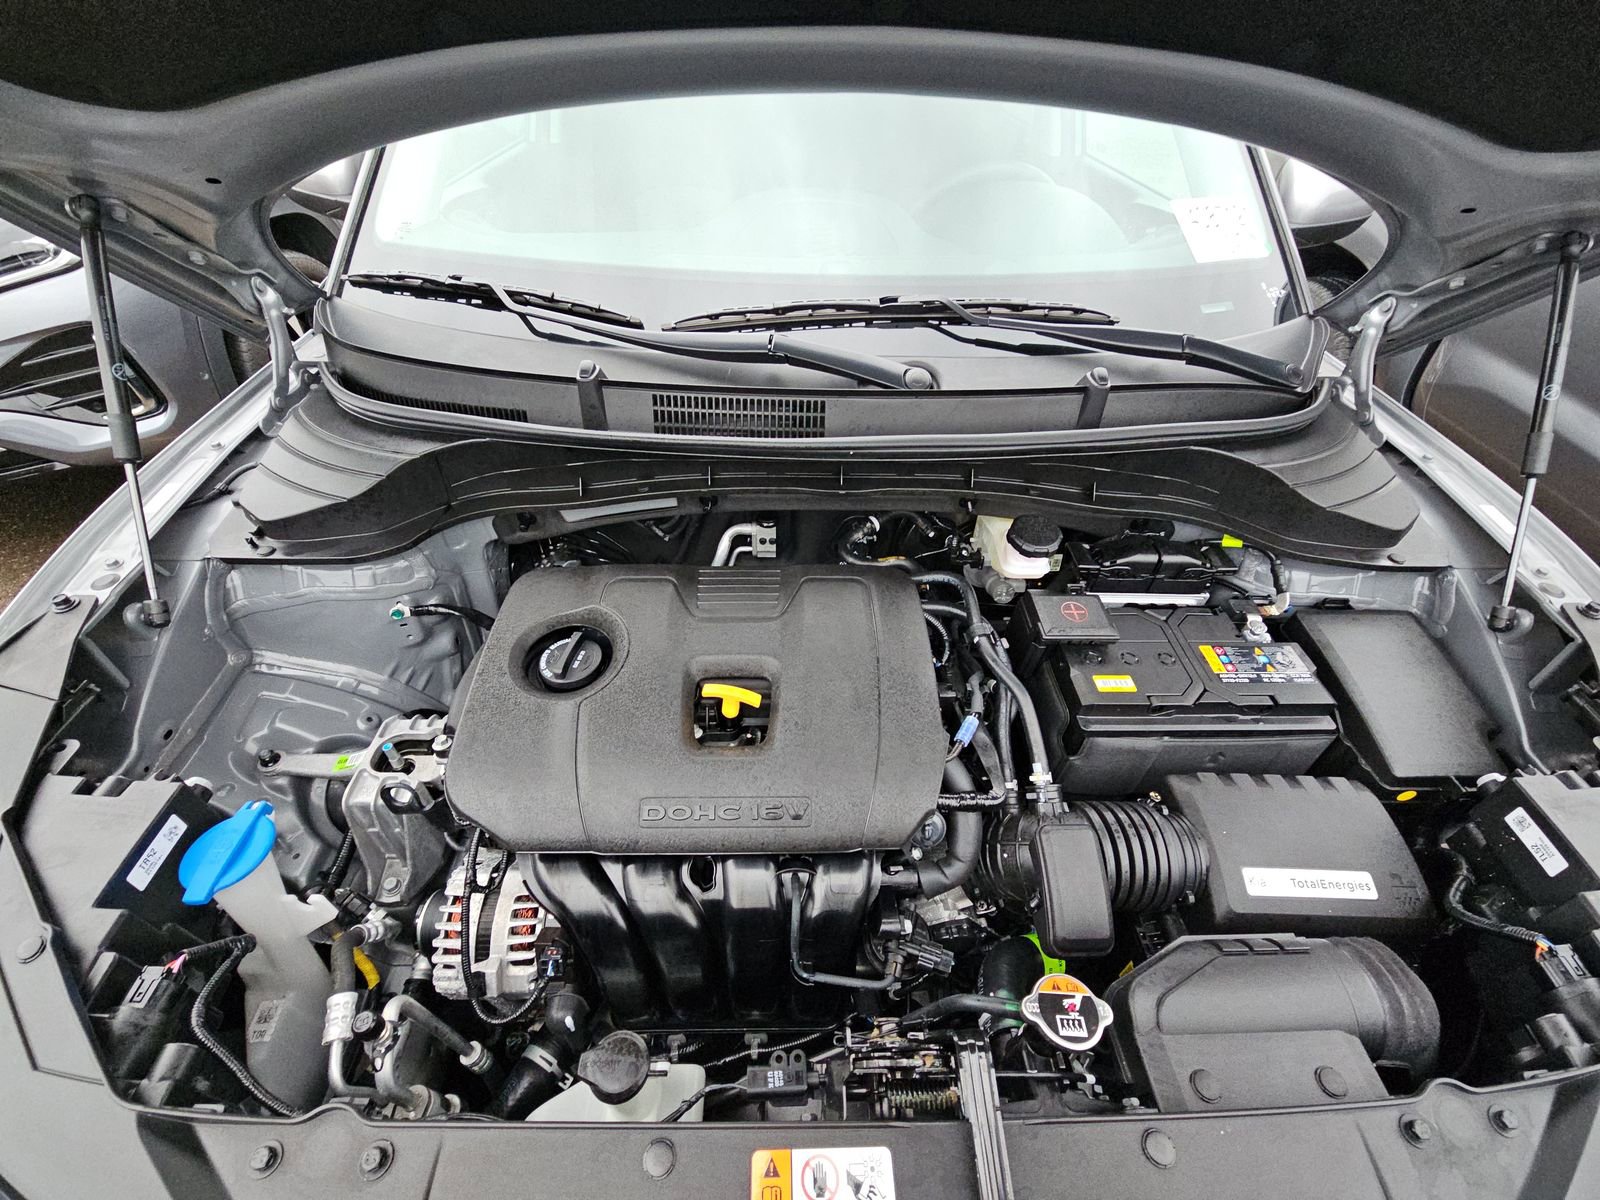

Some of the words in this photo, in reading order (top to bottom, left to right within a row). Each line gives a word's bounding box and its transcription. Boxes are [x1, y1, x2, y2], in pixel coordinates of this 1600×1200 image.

[641, 804, 742, 821] DOHC
[751, 802, 810, 821] 16V
[1290, 878, 1372, 893] TotalEnergies
